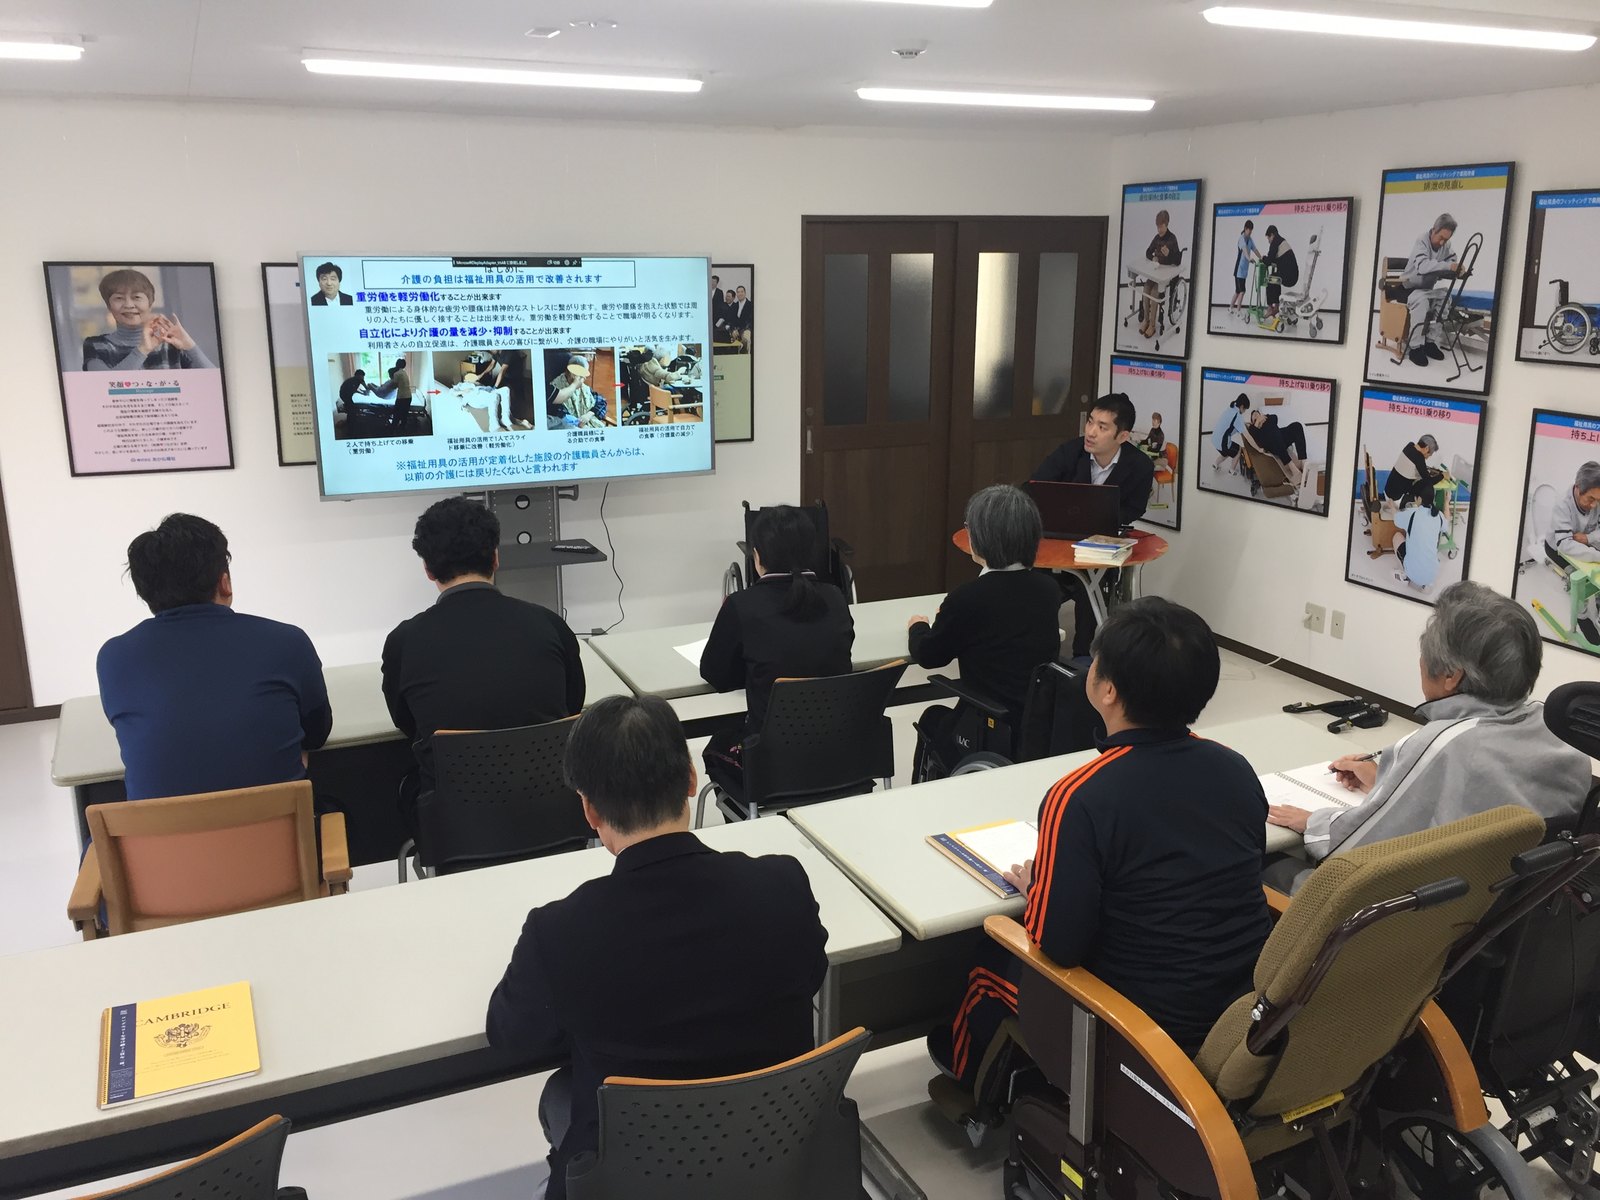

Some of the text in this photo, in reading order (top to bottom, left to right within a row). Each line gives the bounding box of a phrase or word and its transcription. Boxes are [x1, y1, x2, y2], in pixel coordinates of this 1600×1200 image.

[401, 274, 602, 285] 介護の負担は福祉用具の活用で改善されます
[356, 292, 502, 302] 重労働を軽労働化することが出来ます
[1279, 379, 1331, 391] 持ち上げない乗り移り
[1388, 403, 1451, 419] 持ち上げない乗り移り
[1571, 429, 1600, 442] 持ち上
[404, 462, 578, 482] 以前の介護には戻りたくないと言われます
